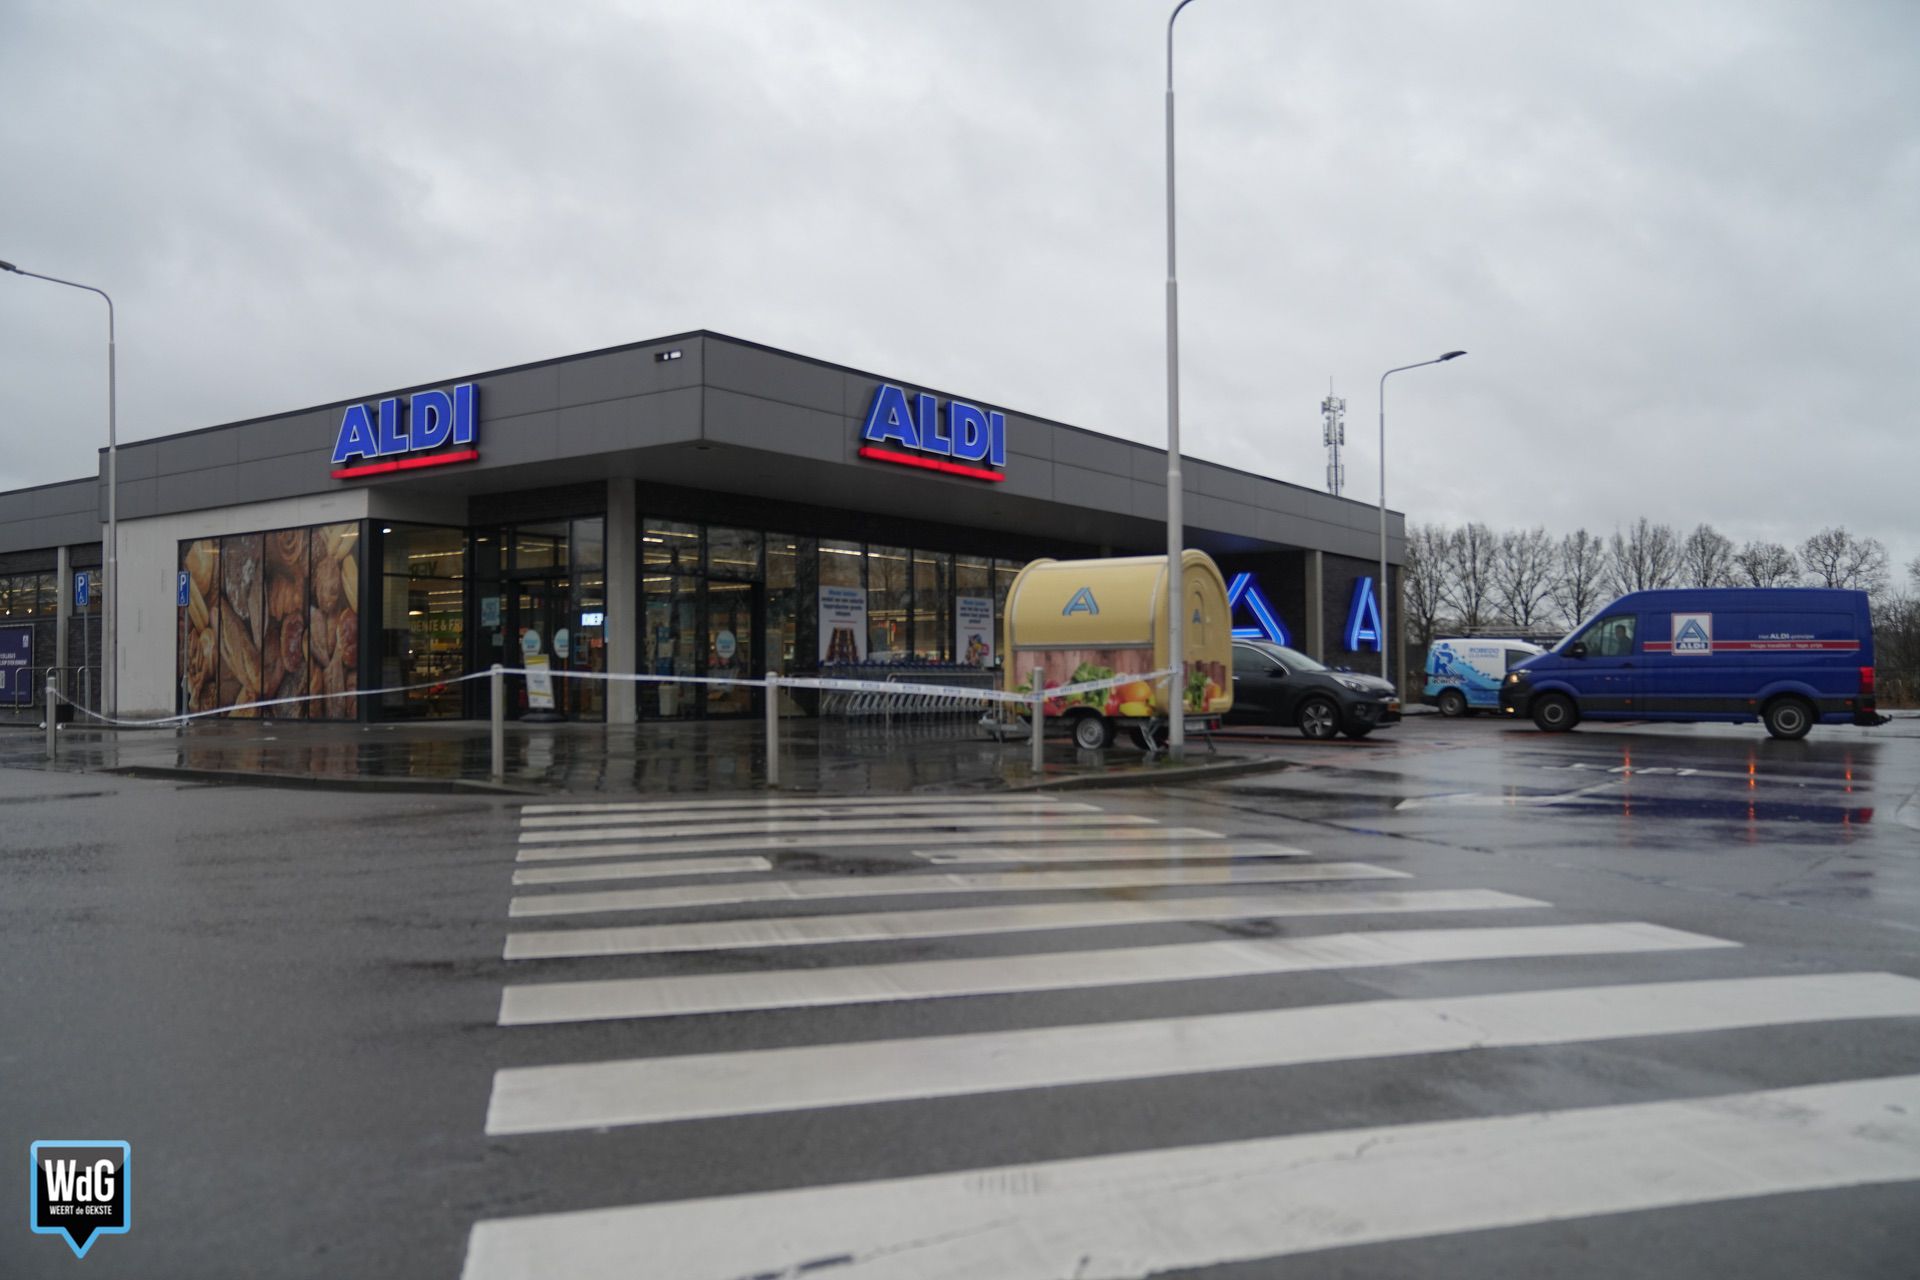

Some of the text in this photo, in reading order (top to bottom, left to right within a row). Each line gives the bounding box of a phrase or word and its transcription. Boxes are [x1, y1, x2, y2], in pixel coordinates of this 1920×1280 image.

[331, 383, 479, 464] ALDI
[861, 383, 1005, 467] ALDI
[78, 576, 85, 593] P
[180, 574, 187, 591] P
[1770, 632, 1790, 640] ALDI
[1679, 642, 1706, 650] ALDI
